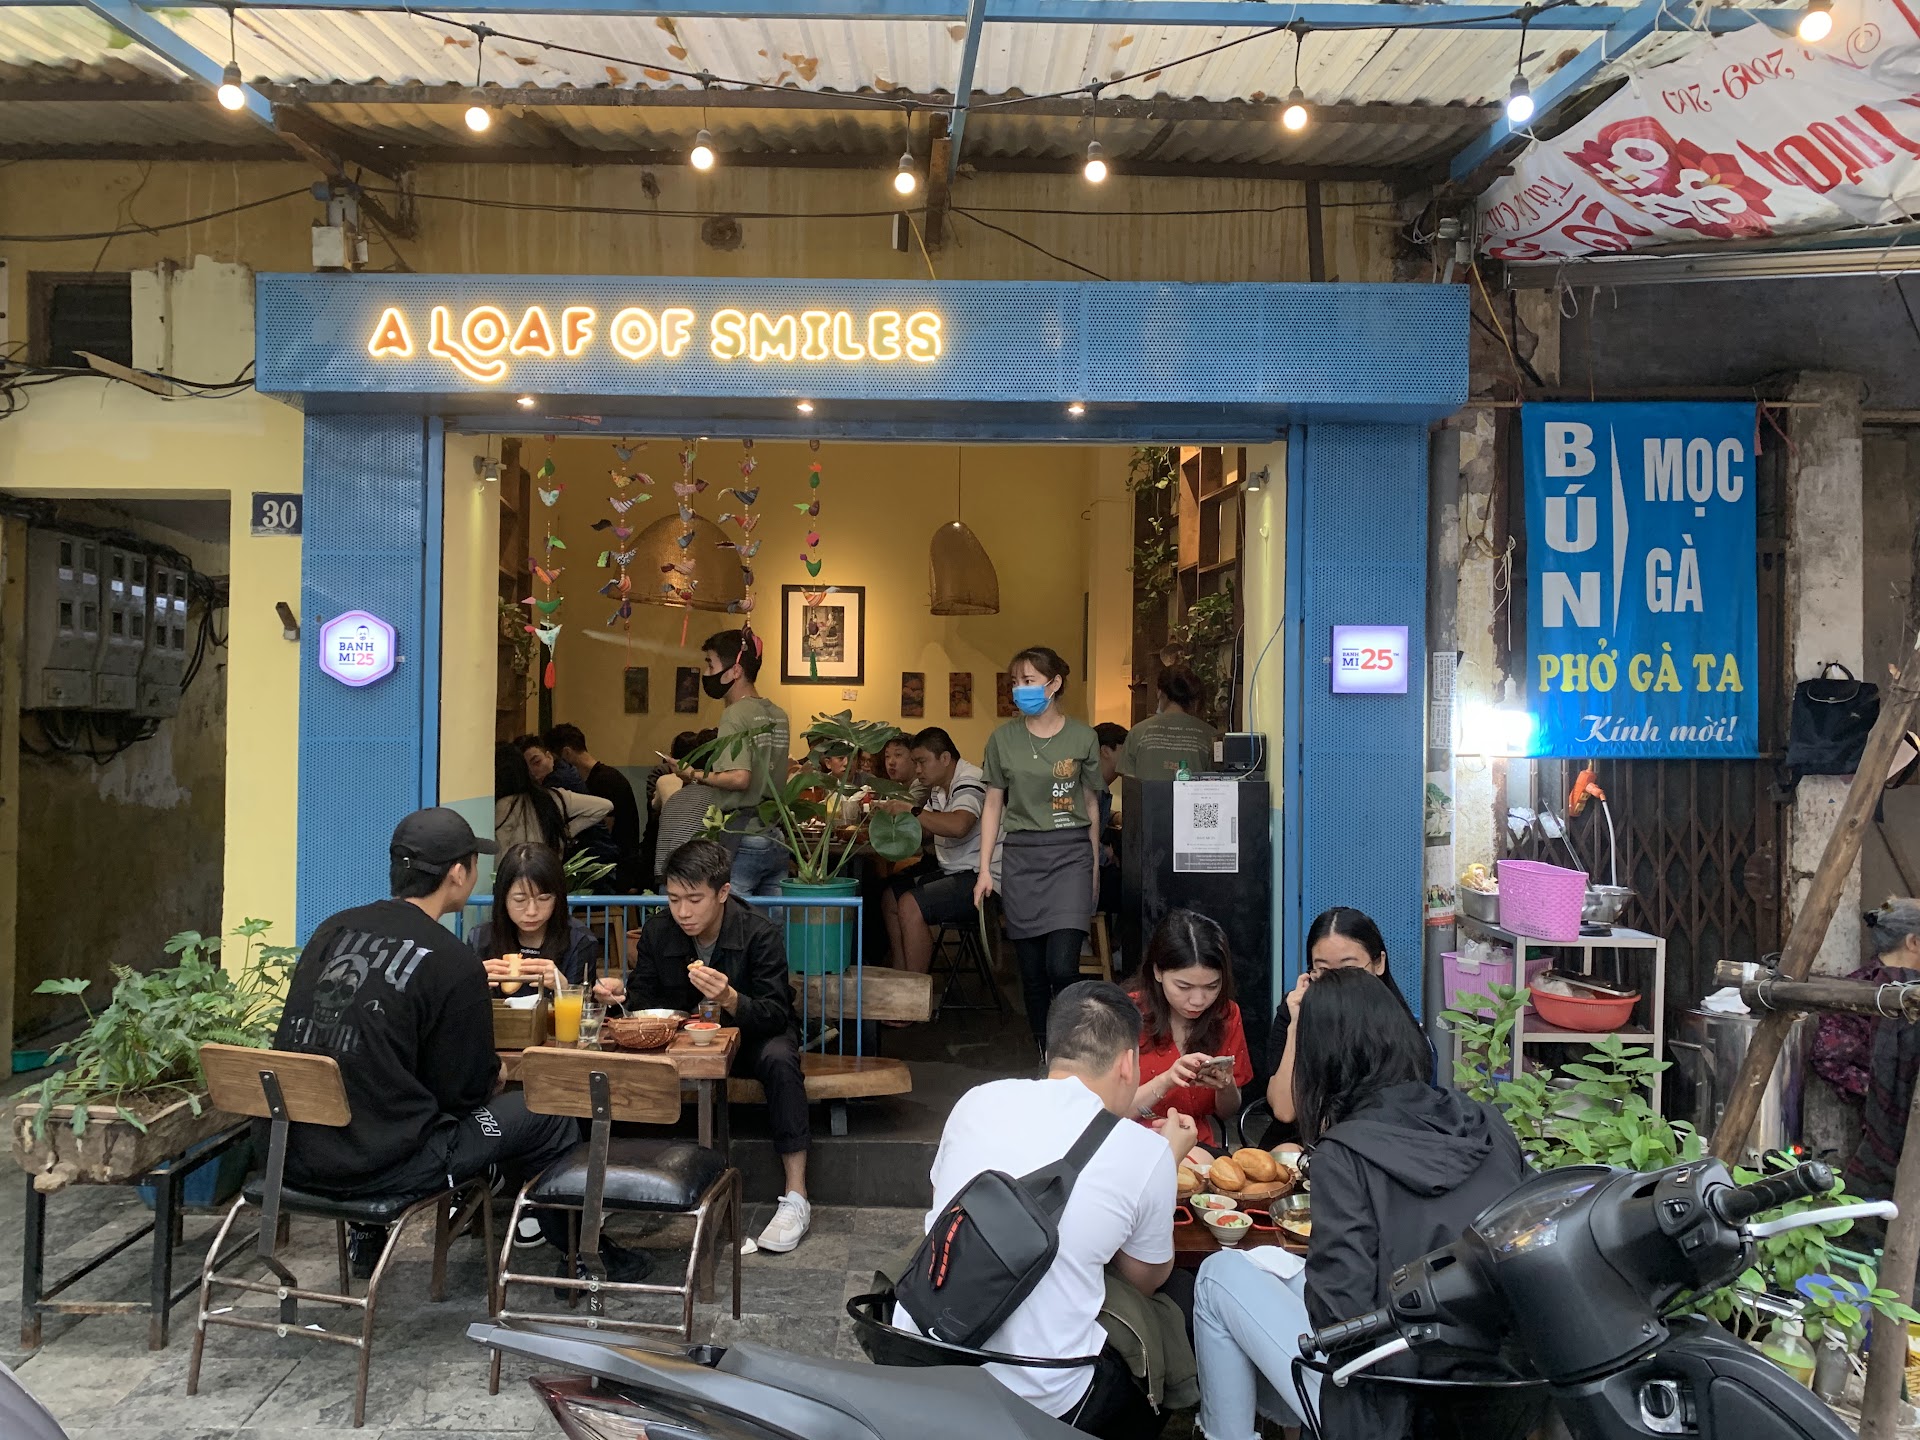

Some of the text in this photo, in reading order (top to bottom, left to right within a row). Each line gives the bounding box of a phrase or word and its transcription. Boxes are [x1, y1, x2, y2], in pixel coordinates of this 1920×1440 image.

[1590, 138, 1669, 190] OFF
[367, 304, 943, 382] A LOAF OF SMILES
[1643, 437, 1745, 518] MỌC
[261, 499, 298, 529] 30
[1542, 422, 1600, 628] BÚN
[1645, 533, 1704, 614] GÀ
[338, 642, 374, 651] BANH
[1342, 658, 1359, 667] MI
[1360, 648, 1394, 671] 25
[1538, 637, 1744, 693] PHỞ GÀ TA
[1574, 715, 1739, 743] Kính mời!
